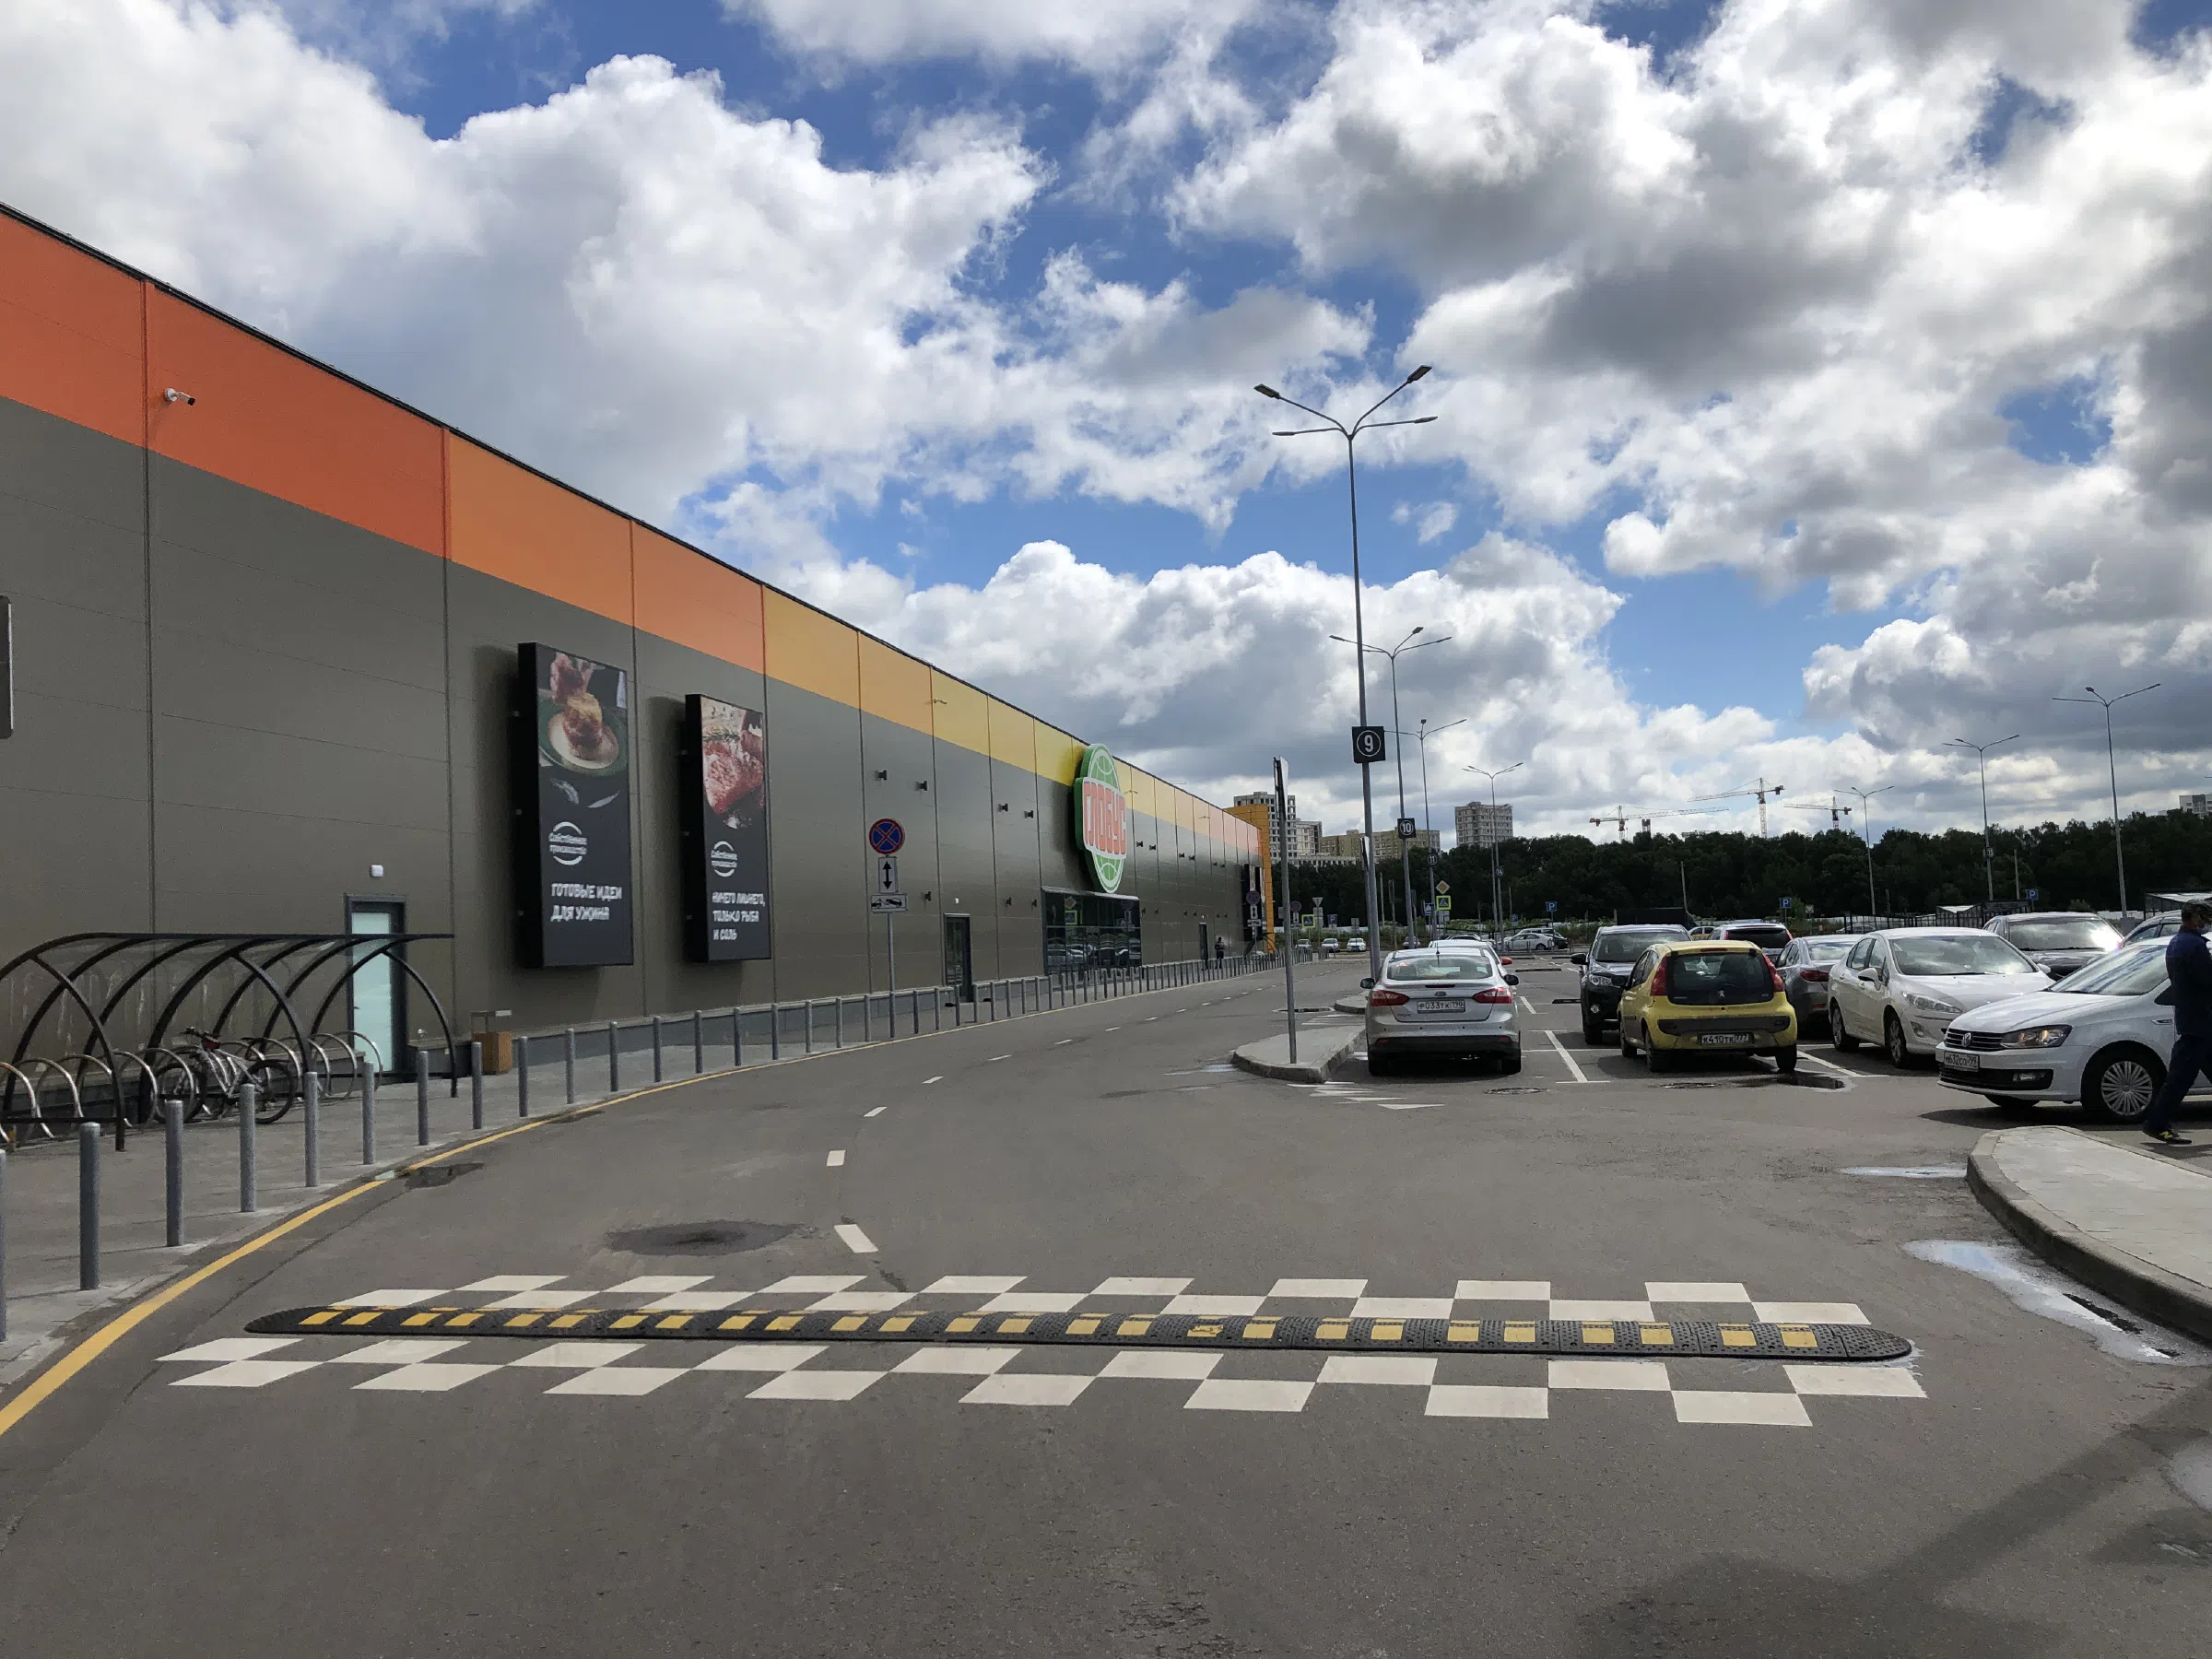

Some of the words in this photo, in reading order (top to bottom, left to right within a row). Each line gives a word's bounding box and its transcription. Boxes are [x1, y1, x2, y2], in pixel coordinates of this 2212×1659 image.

[1364, 735, 1373, 752] 9
[1083, 780, 1126, 855] ГЛОБУС
[1402, 823, 1412, 833] 10
[1429, 855, 1436, 864] 11
[551, 883, 596, 899] ГОТОВЫЕ
[596, 886, 623, 902] ИДЕИ
[550, 905, 574, 922] ДЛЯ
[712, 910, 741, 923] ТОЛЬКО
